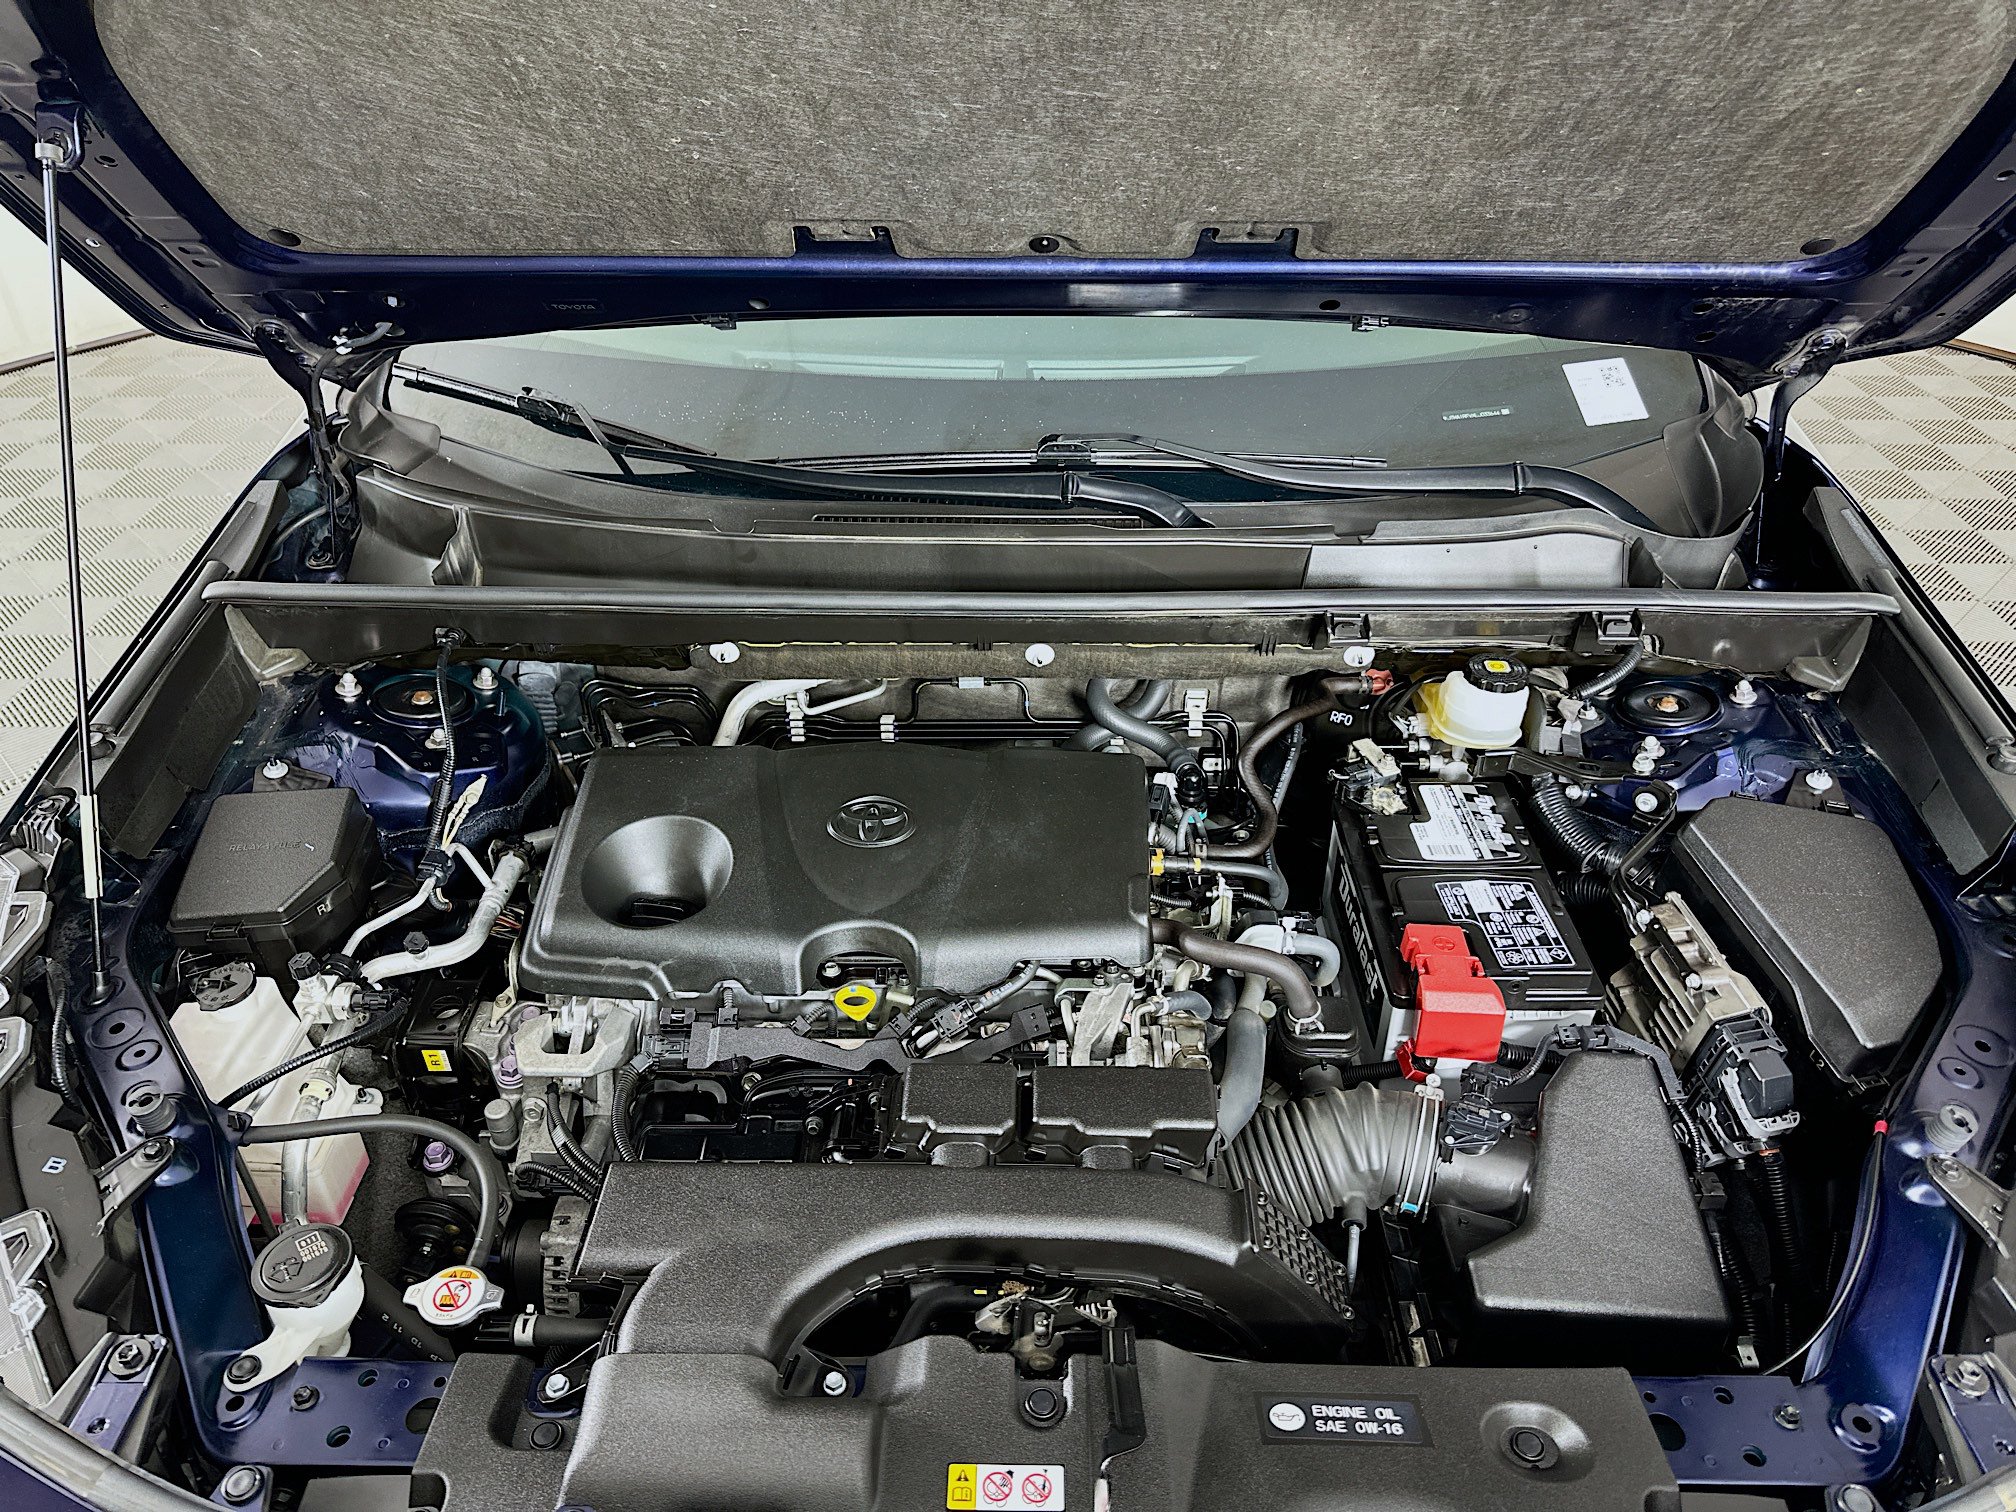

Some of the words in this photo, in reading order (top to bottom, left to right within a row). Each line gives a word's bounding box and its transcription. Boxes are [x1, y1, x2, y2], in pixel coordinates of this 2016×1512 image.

[550, 303, 597, 311] TOYOTA
[228, 843, 263, 852] RELAY
[1338, 862, 1380, 1000] Duralast
[41, 1156, 68, 1174] B
[1311, 1404, 1369, 1419] ENGINE
[1374, 1407, 1402, 1421] OIL
[1315, 1419, 1349, 1433] SAE
